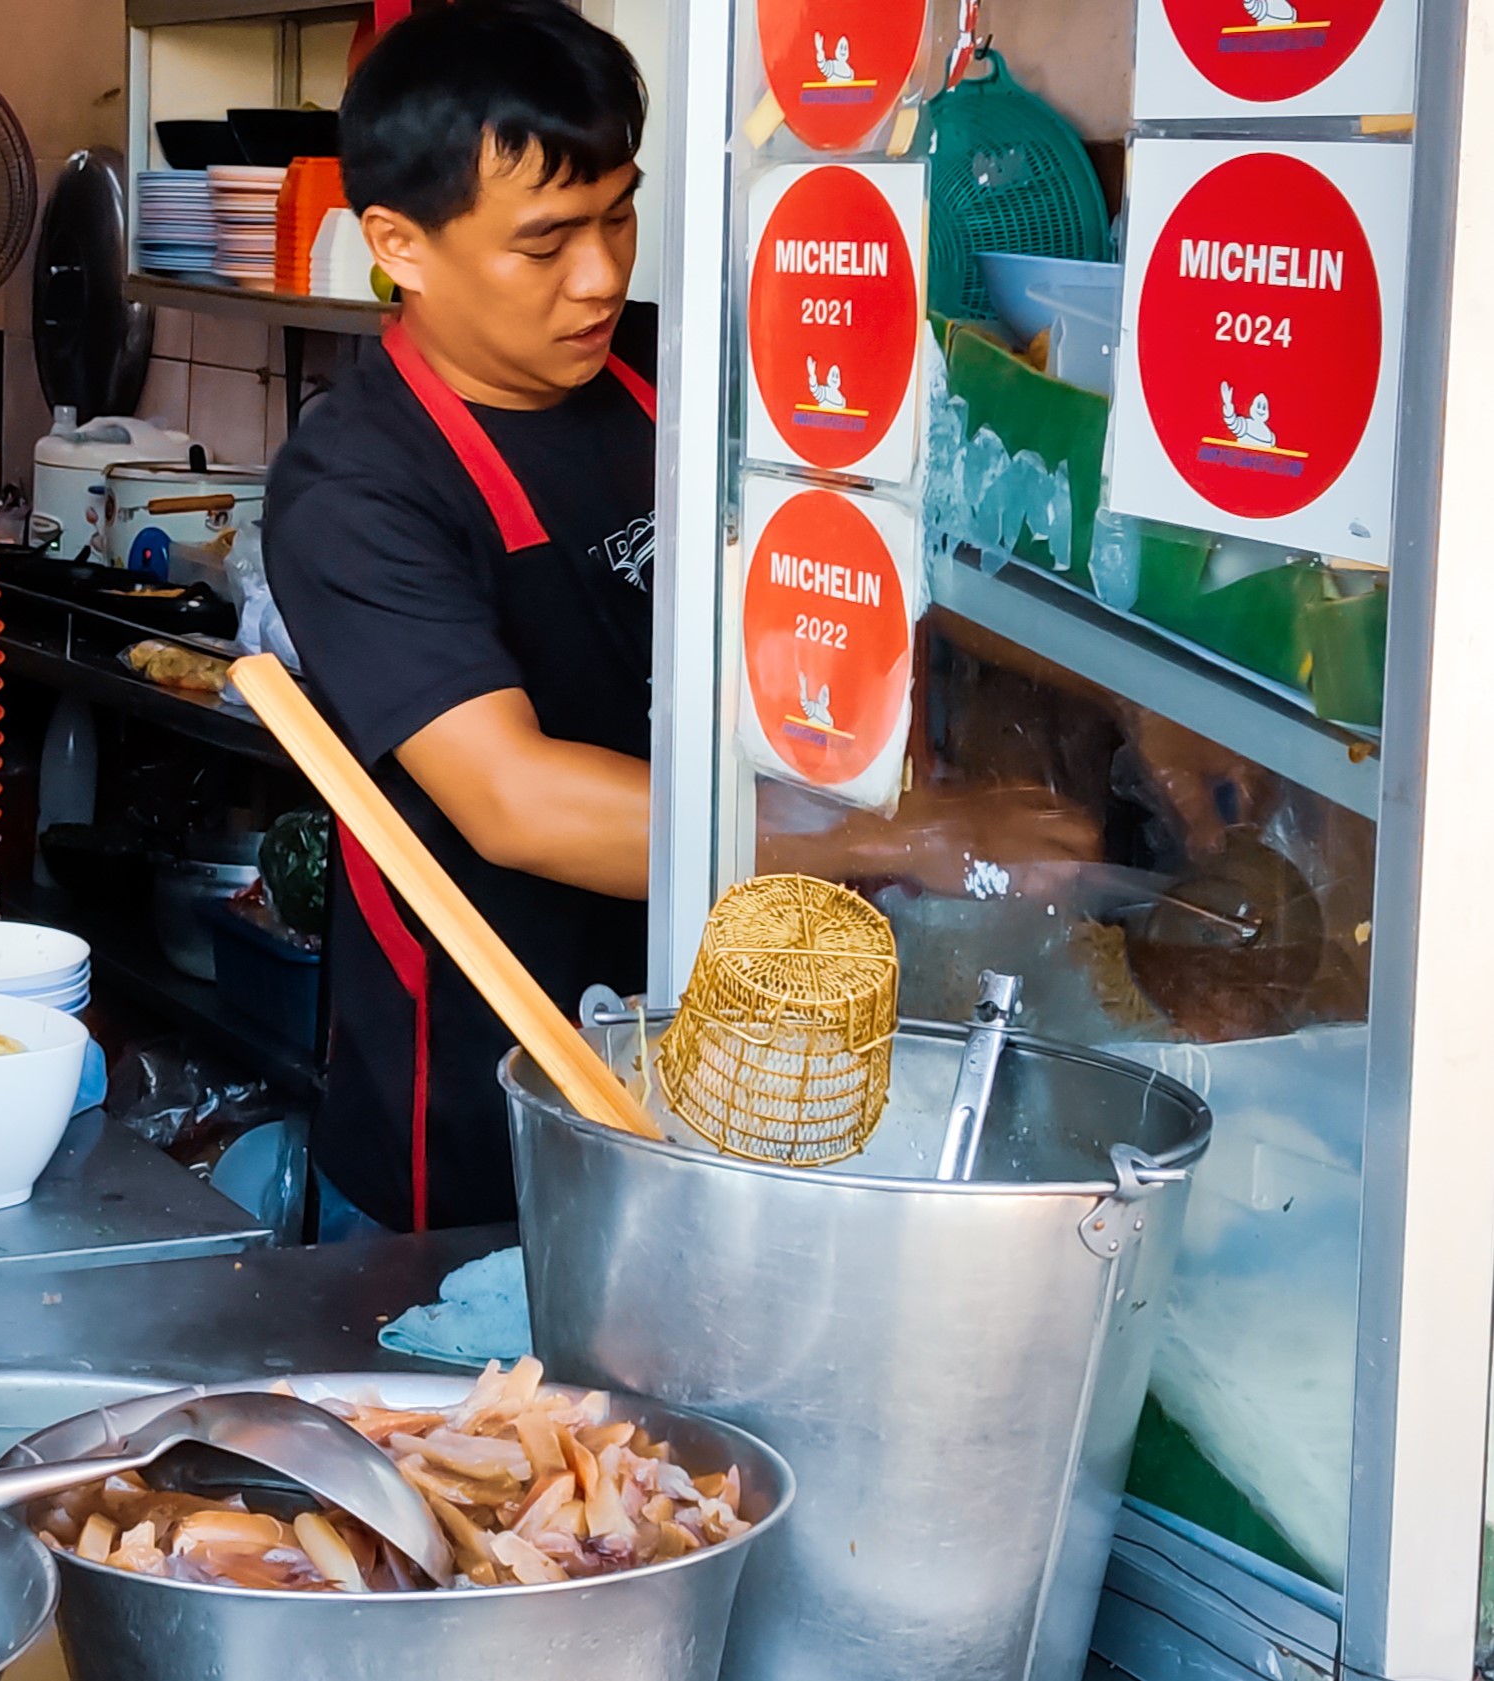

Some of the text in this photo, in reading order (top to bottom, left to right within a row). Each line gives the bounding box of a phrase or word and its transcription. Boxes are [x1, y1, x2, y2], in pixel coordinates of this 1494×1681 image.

[775, 239, 889, 278] MICHELIN
[1179, 239, 1344, 292] MICHELIN
[801, 298, 853, 327] 2021
[1215, 311, 1292, 349] 2024
[770, 551, 882, 608] MICHELIN
[794, 613, 848, 650] 2022
